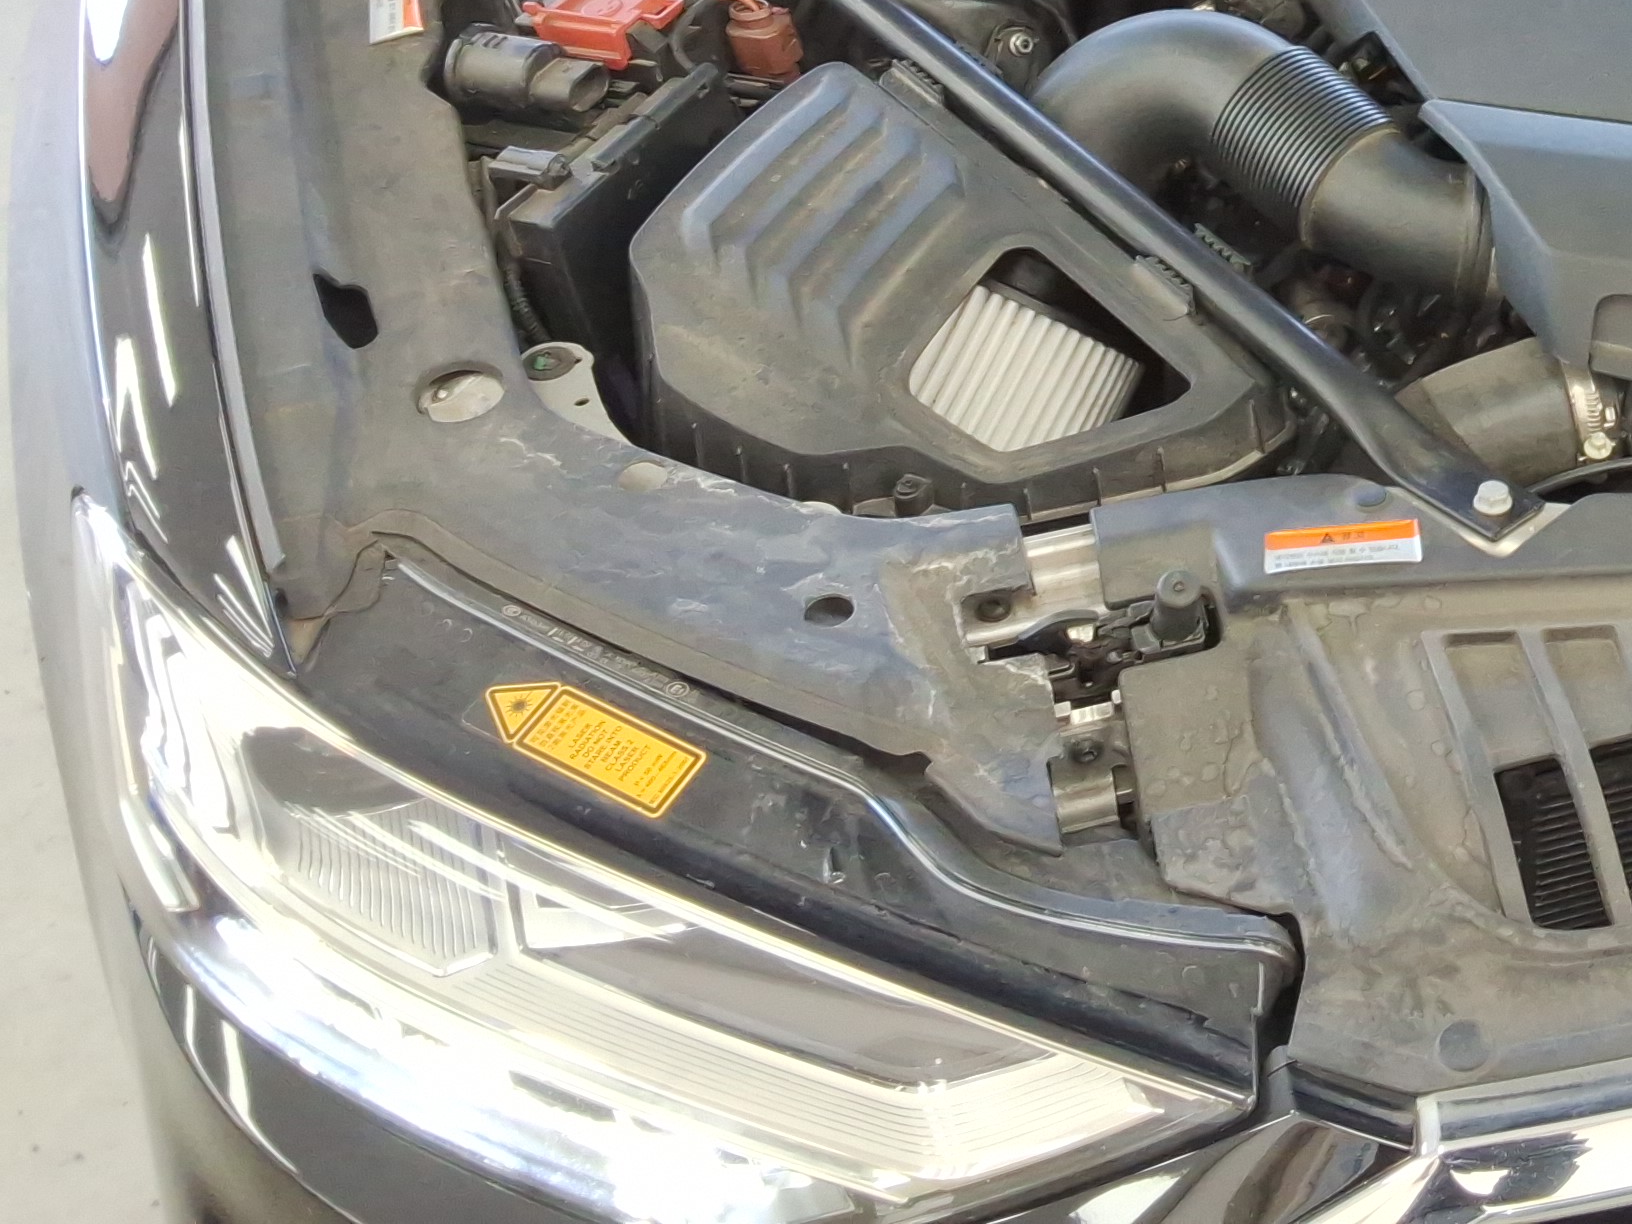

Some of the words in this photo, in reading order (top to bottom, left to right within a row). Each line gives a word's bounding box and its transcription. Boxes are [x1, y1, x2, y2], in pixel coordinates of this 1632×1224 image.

[567, 722, 592, 748] LASER
[569, 720, 606, 760] RADIATION
[581, 745, 593, 758] DO
[593, 729, 608, 745] NOT
[583, 744, 606, 769] STARE
[604, 745, 628, 771] CLASS
[615, 746, 638, 772] LASER
[617, 744, 651, 781] PRODUCT
